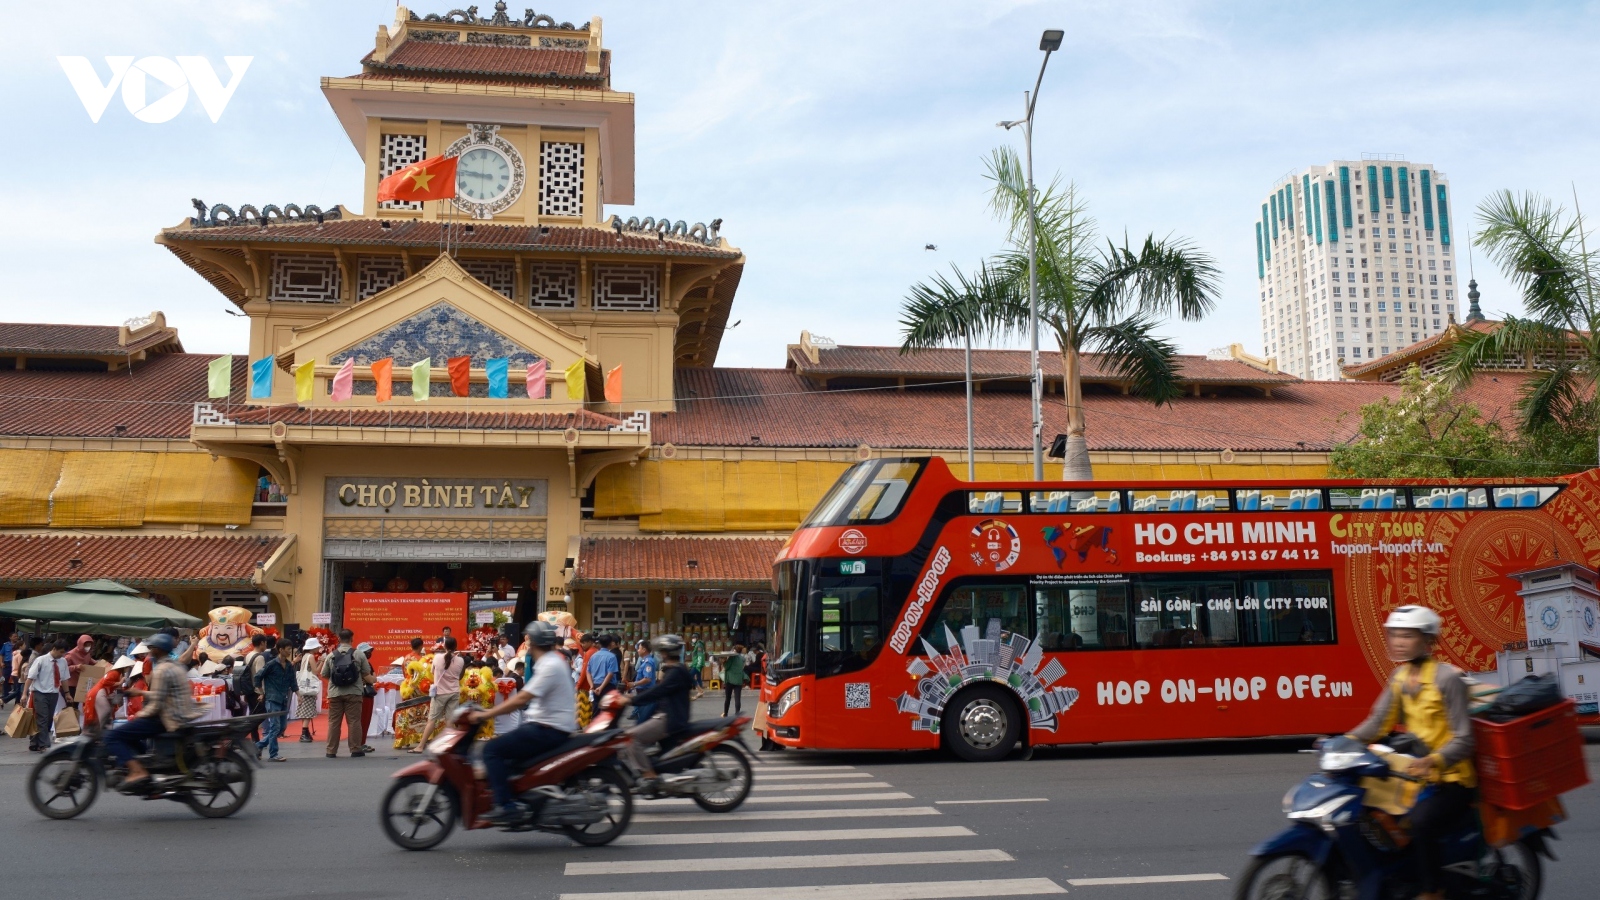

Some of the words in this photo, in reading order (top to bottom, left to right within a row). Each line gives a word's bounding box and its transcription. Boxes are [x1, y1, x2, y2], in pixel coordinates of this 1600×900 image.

[338, 481, 397, 513] CHỢ
[403, 479, 475, 508] BÌNH
[480, 480, 535, 508] TÂY
[1134, 523, 1178, 546] HO
[1184, 522, 1235, 545] CHI
[1242, 521, 1317, 544] MINH
[1201, 551, 1228, 562] +84
[1232, 550, 1257, 561] 913
[1260, 550, 1278, 561] 67
[1281, 549, 1299, 560] 44
[1303, 549, 1320, 560] 12
[1331, 539, 1444, 558] hopon-hopoff.vn
[549, 587, 566, 596] 57A
[890, 620, 912, 654] HOP
[931, 546, 951, 575] OFF
[1140, 596, 1162, 612] SÀI
[1165, 596, 1191, 612] GÒN
[1207, 597, 1232, 613] CHỢ
[1235, 596, 1260, 611] LỚN
[1263, 598, 1292, 610] CITY
[1295, 597, 1328, 609] TOUR
[1096, 680, 1151, 706] HOP
[1276, 674, 1353, 699] OFF.VN
